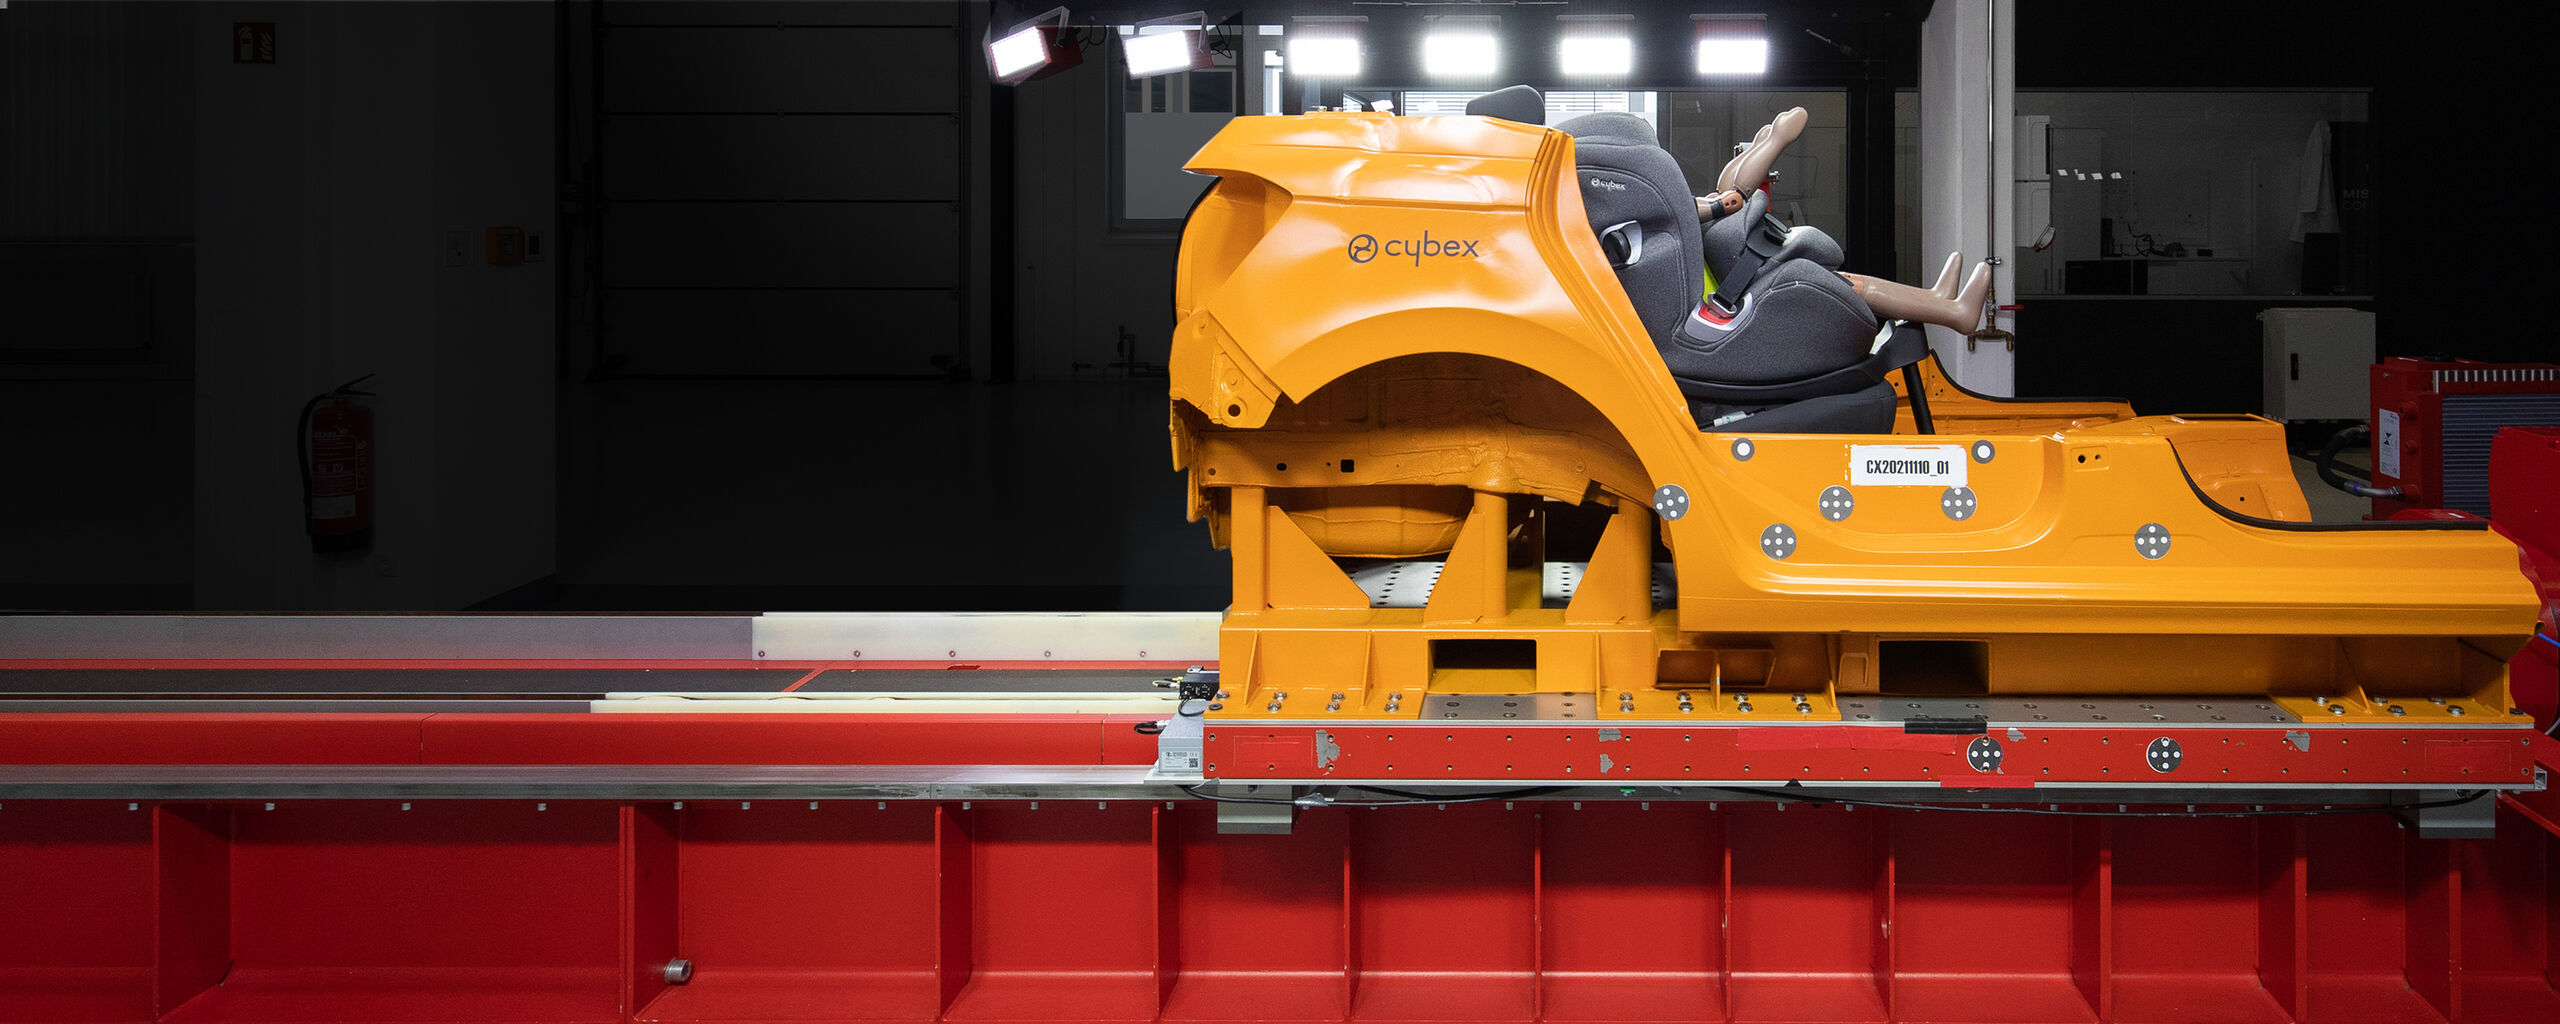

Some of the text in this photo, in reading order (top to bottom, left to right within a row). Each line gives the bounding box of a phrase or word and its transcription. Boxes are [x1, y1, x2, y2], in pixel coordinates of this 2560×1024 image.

[1600, 179, 1626, 191] cybex
[1384, 229, 1479, 267] cybex
[1866, 459, 1949, 477] CX20211110_01
